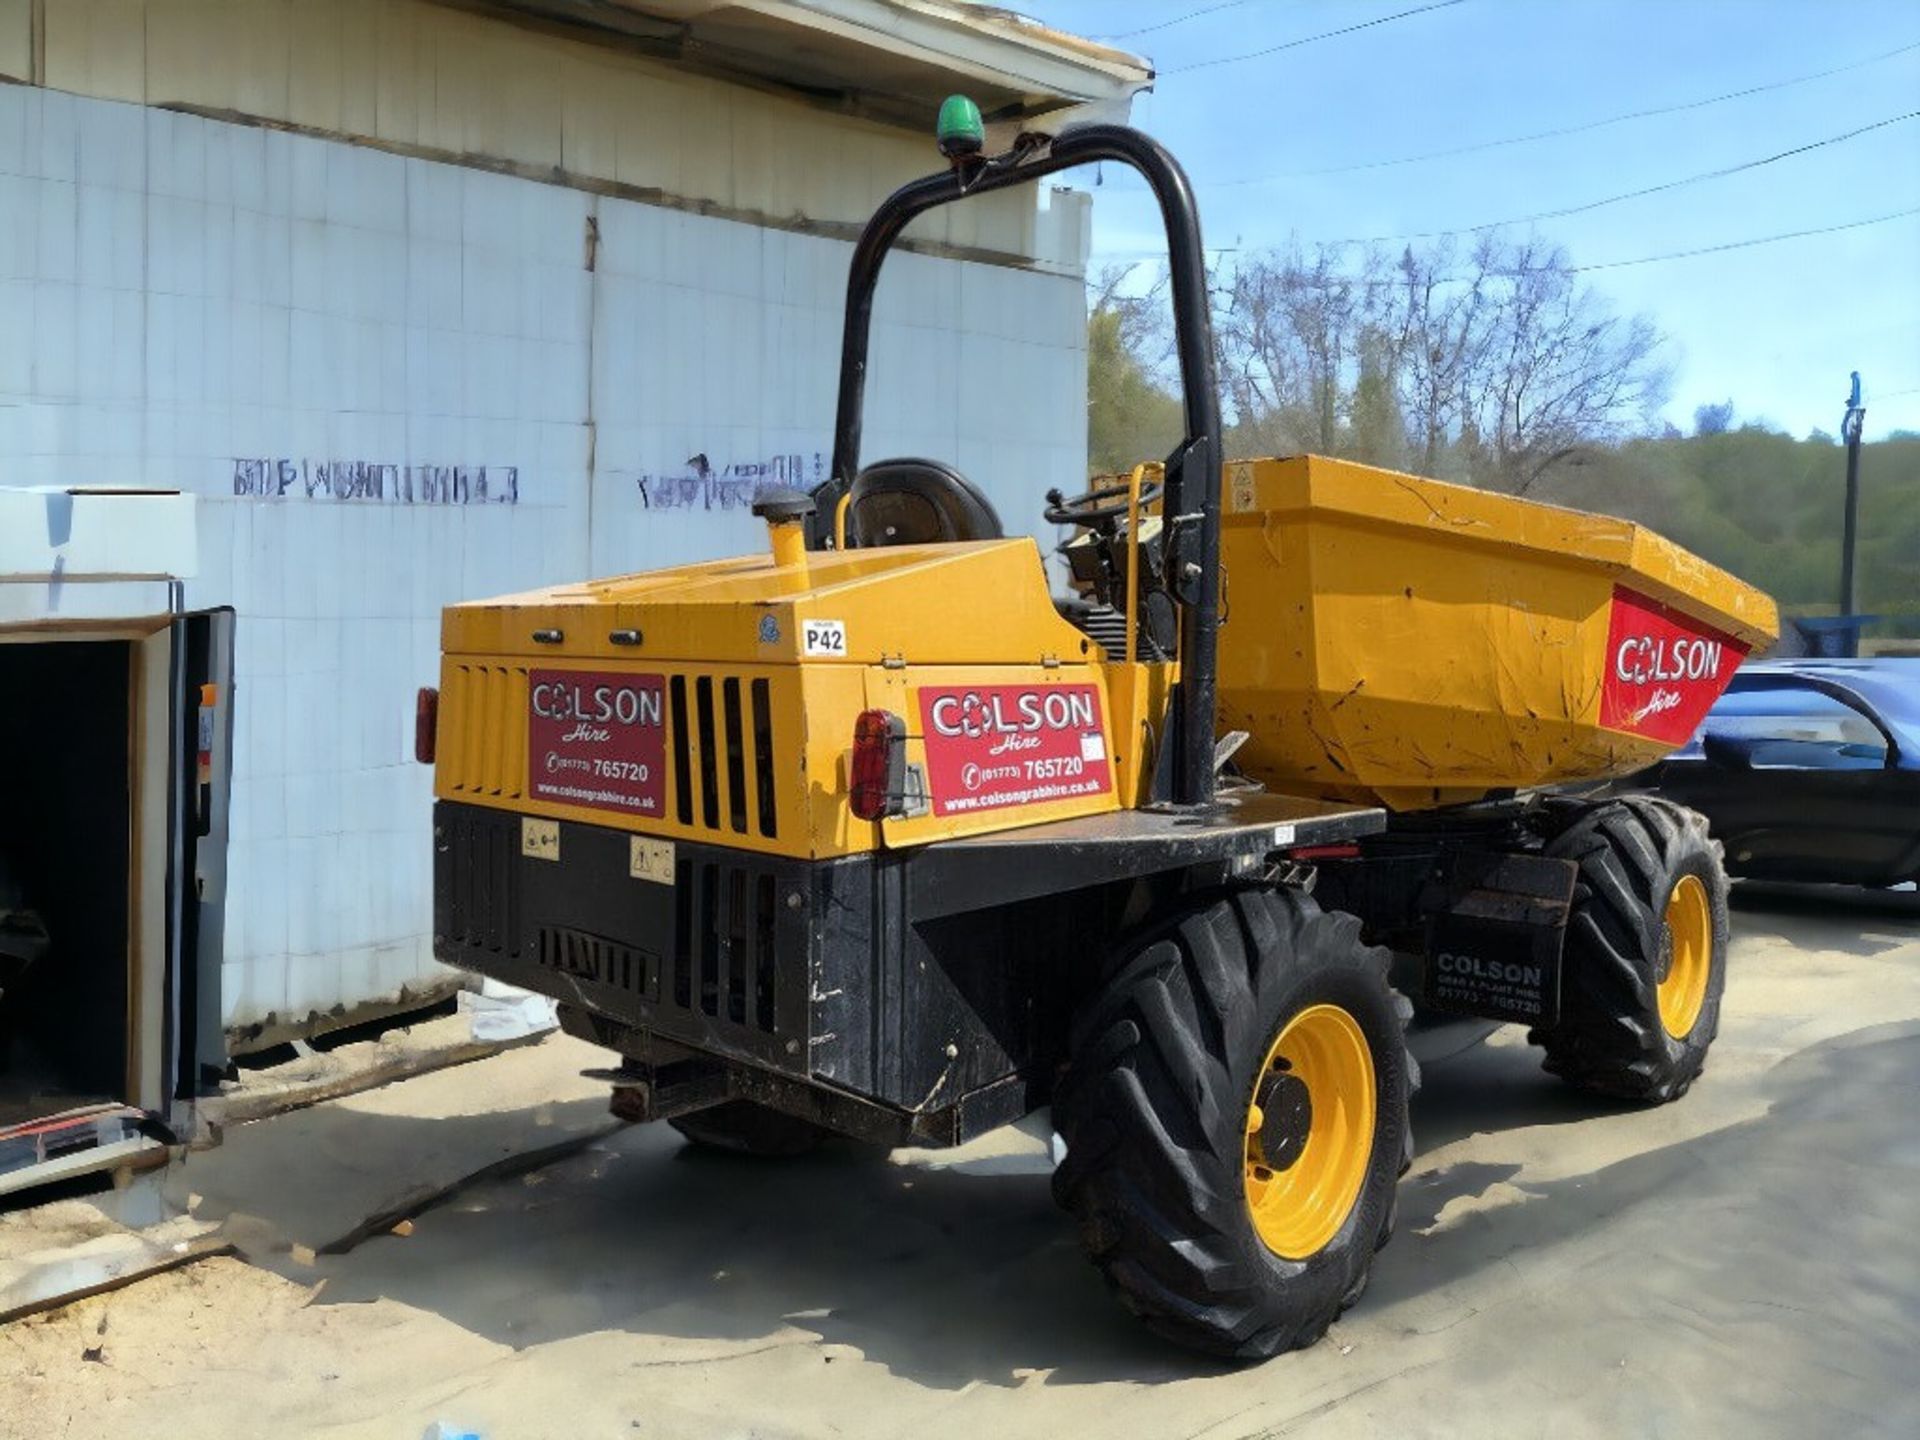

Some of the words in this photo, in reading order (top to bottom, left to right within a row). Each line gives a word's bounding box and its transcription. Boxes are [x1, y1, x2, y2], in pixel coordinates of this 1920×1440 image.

[807, 629, 842, 650] P42
[1616, 636, 1722, 684] COLSON
[532, 682, 662, 726] COLSON
[932, 692, 1095, 738] COLSON
[1633, 688, 1682, 722] Hire
[562, 722, 611, 742] Hire
[989, 733, 1042, 755] Hire
[594, 759, 648, 782] 765720
[981, 766, 1021, 782] (01773)
[1024, 756, 1083, 780] 765720
[538, 783, 656, 809] www.colsongrabhire.co.uk
[944, 779, 1100, 811] www.colsongrabhire.co.uk
[1437, 953, 1541, 986] COLSON
